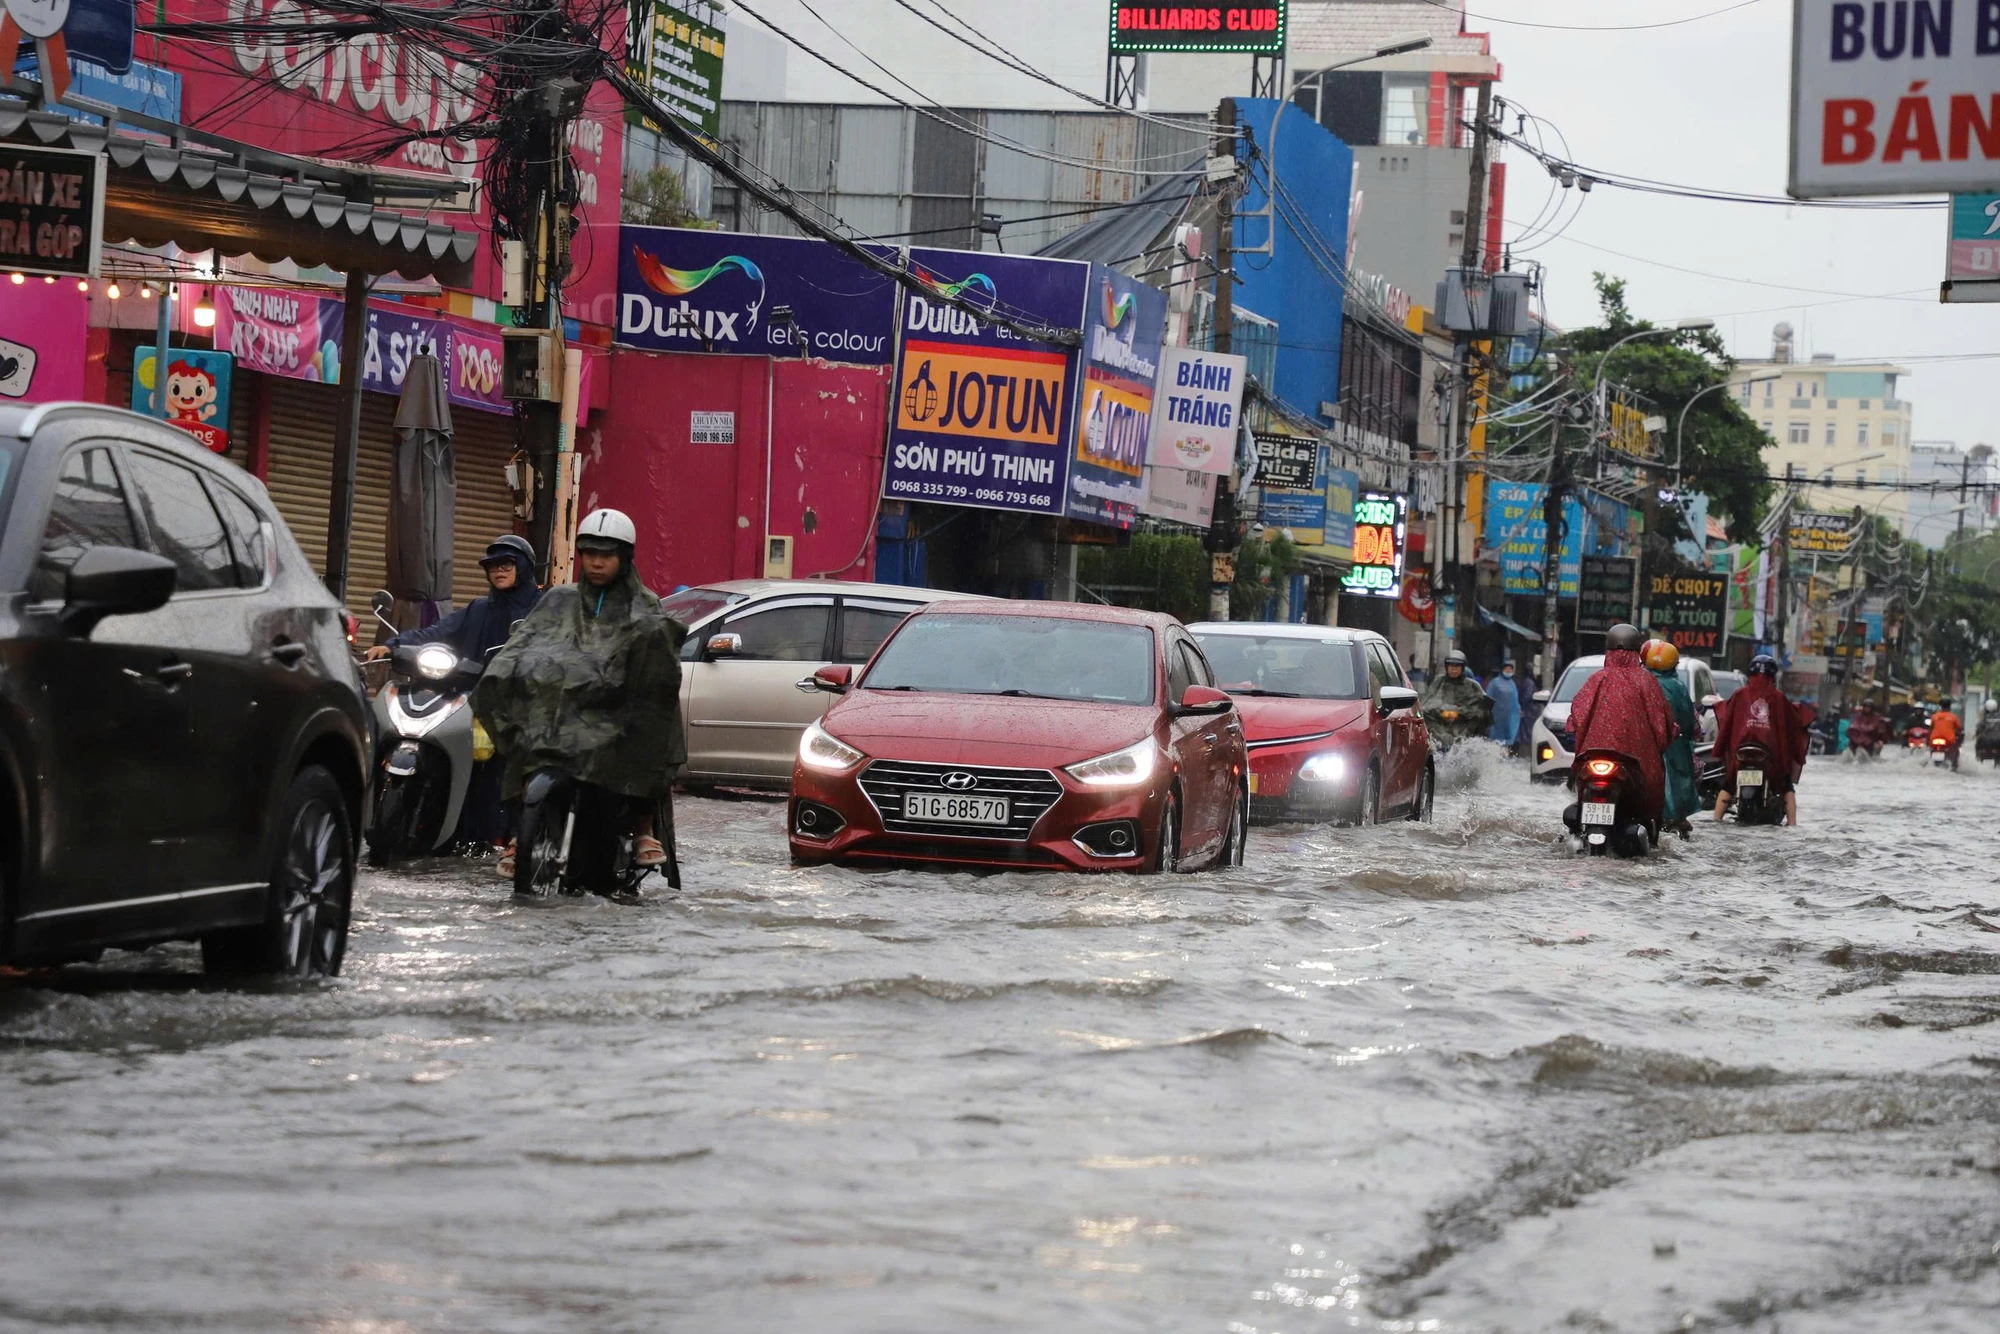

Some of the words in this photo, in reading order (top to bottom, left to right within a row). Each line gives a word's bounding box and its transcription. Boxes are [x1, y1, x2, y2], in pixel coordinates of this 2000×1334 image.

[1117, 8, 1221, 30] BILLIARDS
[1226, 9, 1278, 31] CLUB
[48, 172, 83, 209] XE
[36, 213, 83, 259] GÓP
[264, 294, 299, 326] NHẬT
[622, 293, 739, 342] Dulux
[908, 295, 980, 337] Dulux
[767, 325, 809, 346] let's
[815, 329, 886, 352] colour
[1176, 358, 1232, 392] BÁNH
[938, 371, 1060, 436] JOTUN
[1168, 394, 1232, 428] TRÁNG
[893, 441, 939, 472] SƠN
[942, 446, 986, 477] PHÚ
[991, 453, 1055, 486] THỊNH
[1256, 441, 1310, 462] Bida
[891, 479, 921, 493] 0968
[922, 483, 944, 495] 335
[945, 485, 968, 498] 799
[975, 488, 1004, 502] 0966
[1006, 491, 1027, 504] 793
[1029, 494, 1051, 506] 668
[1674, 579, 1710, 599] CHỌI
[1712, 582, 1724, 597] 7
[907, 796, 1006, 821] 51G-685.70
